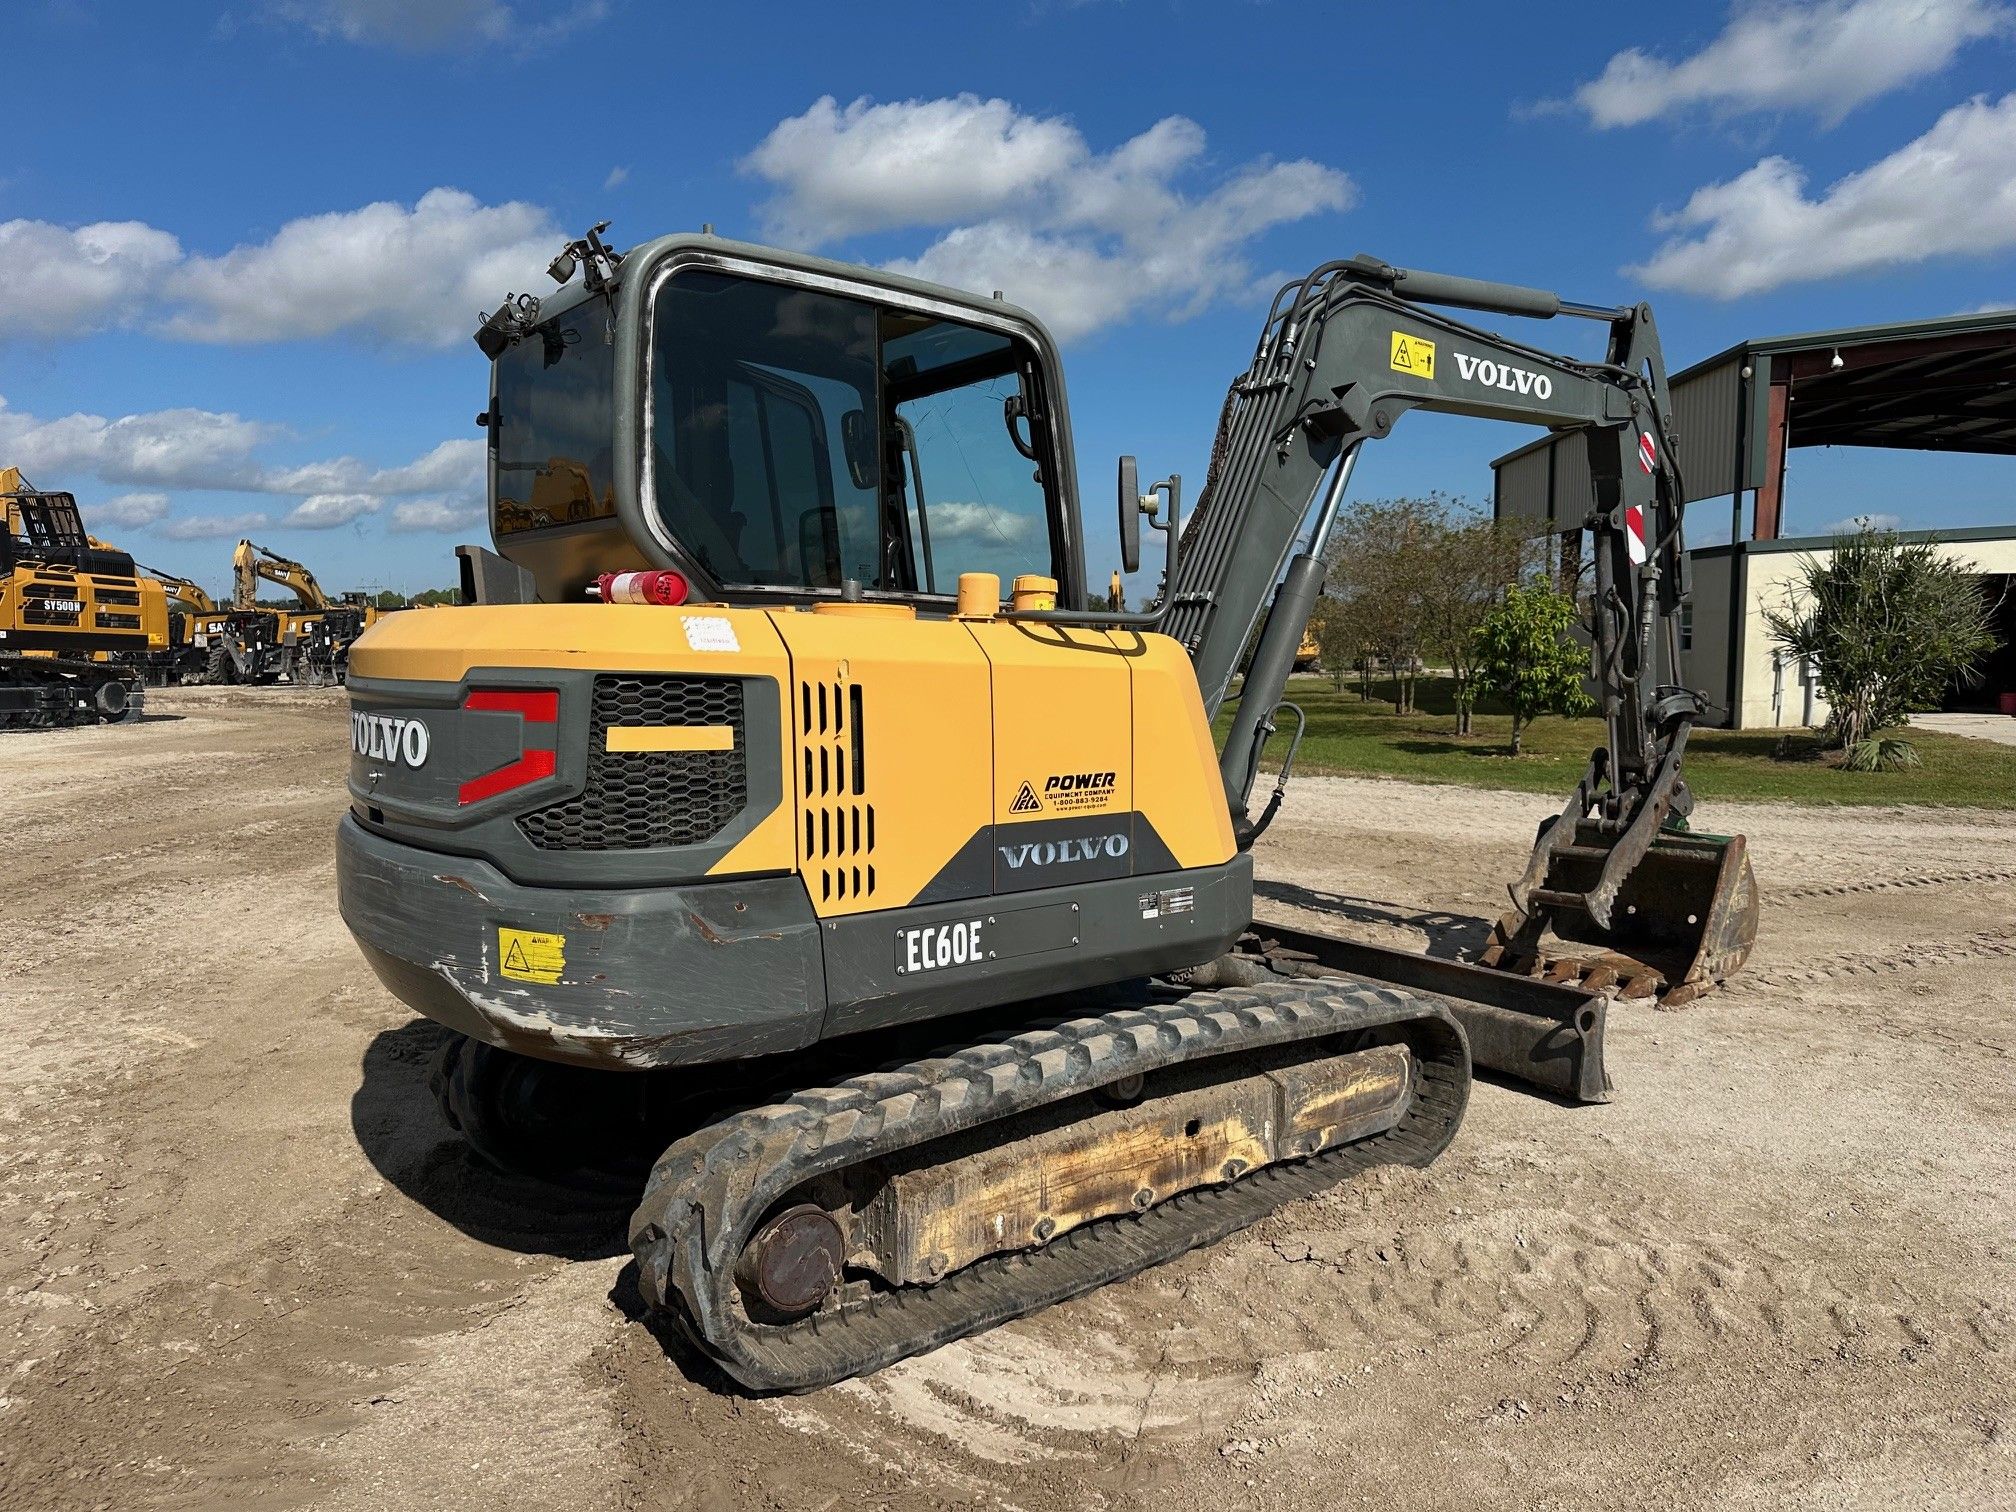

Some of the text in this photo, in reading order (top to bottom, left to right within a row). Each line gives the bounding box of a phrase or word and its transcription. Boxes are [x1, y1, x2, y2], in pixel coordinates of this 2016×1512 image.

[1453, 352, 1553, 400] VOLVO
[44, 600, 81, 612] SY500H
[351, 711, 428, 767] VOLVO
[1044, 789, 1115, 800] EQUIPMENT COMPANY
[1045, 772, 1116, 791] POWER
[1053, 796, 1108, 806] 1-800-883-9284
[999, 833, 1129, 869] VOLVO
[906, 920, 983, 972] EC60E
